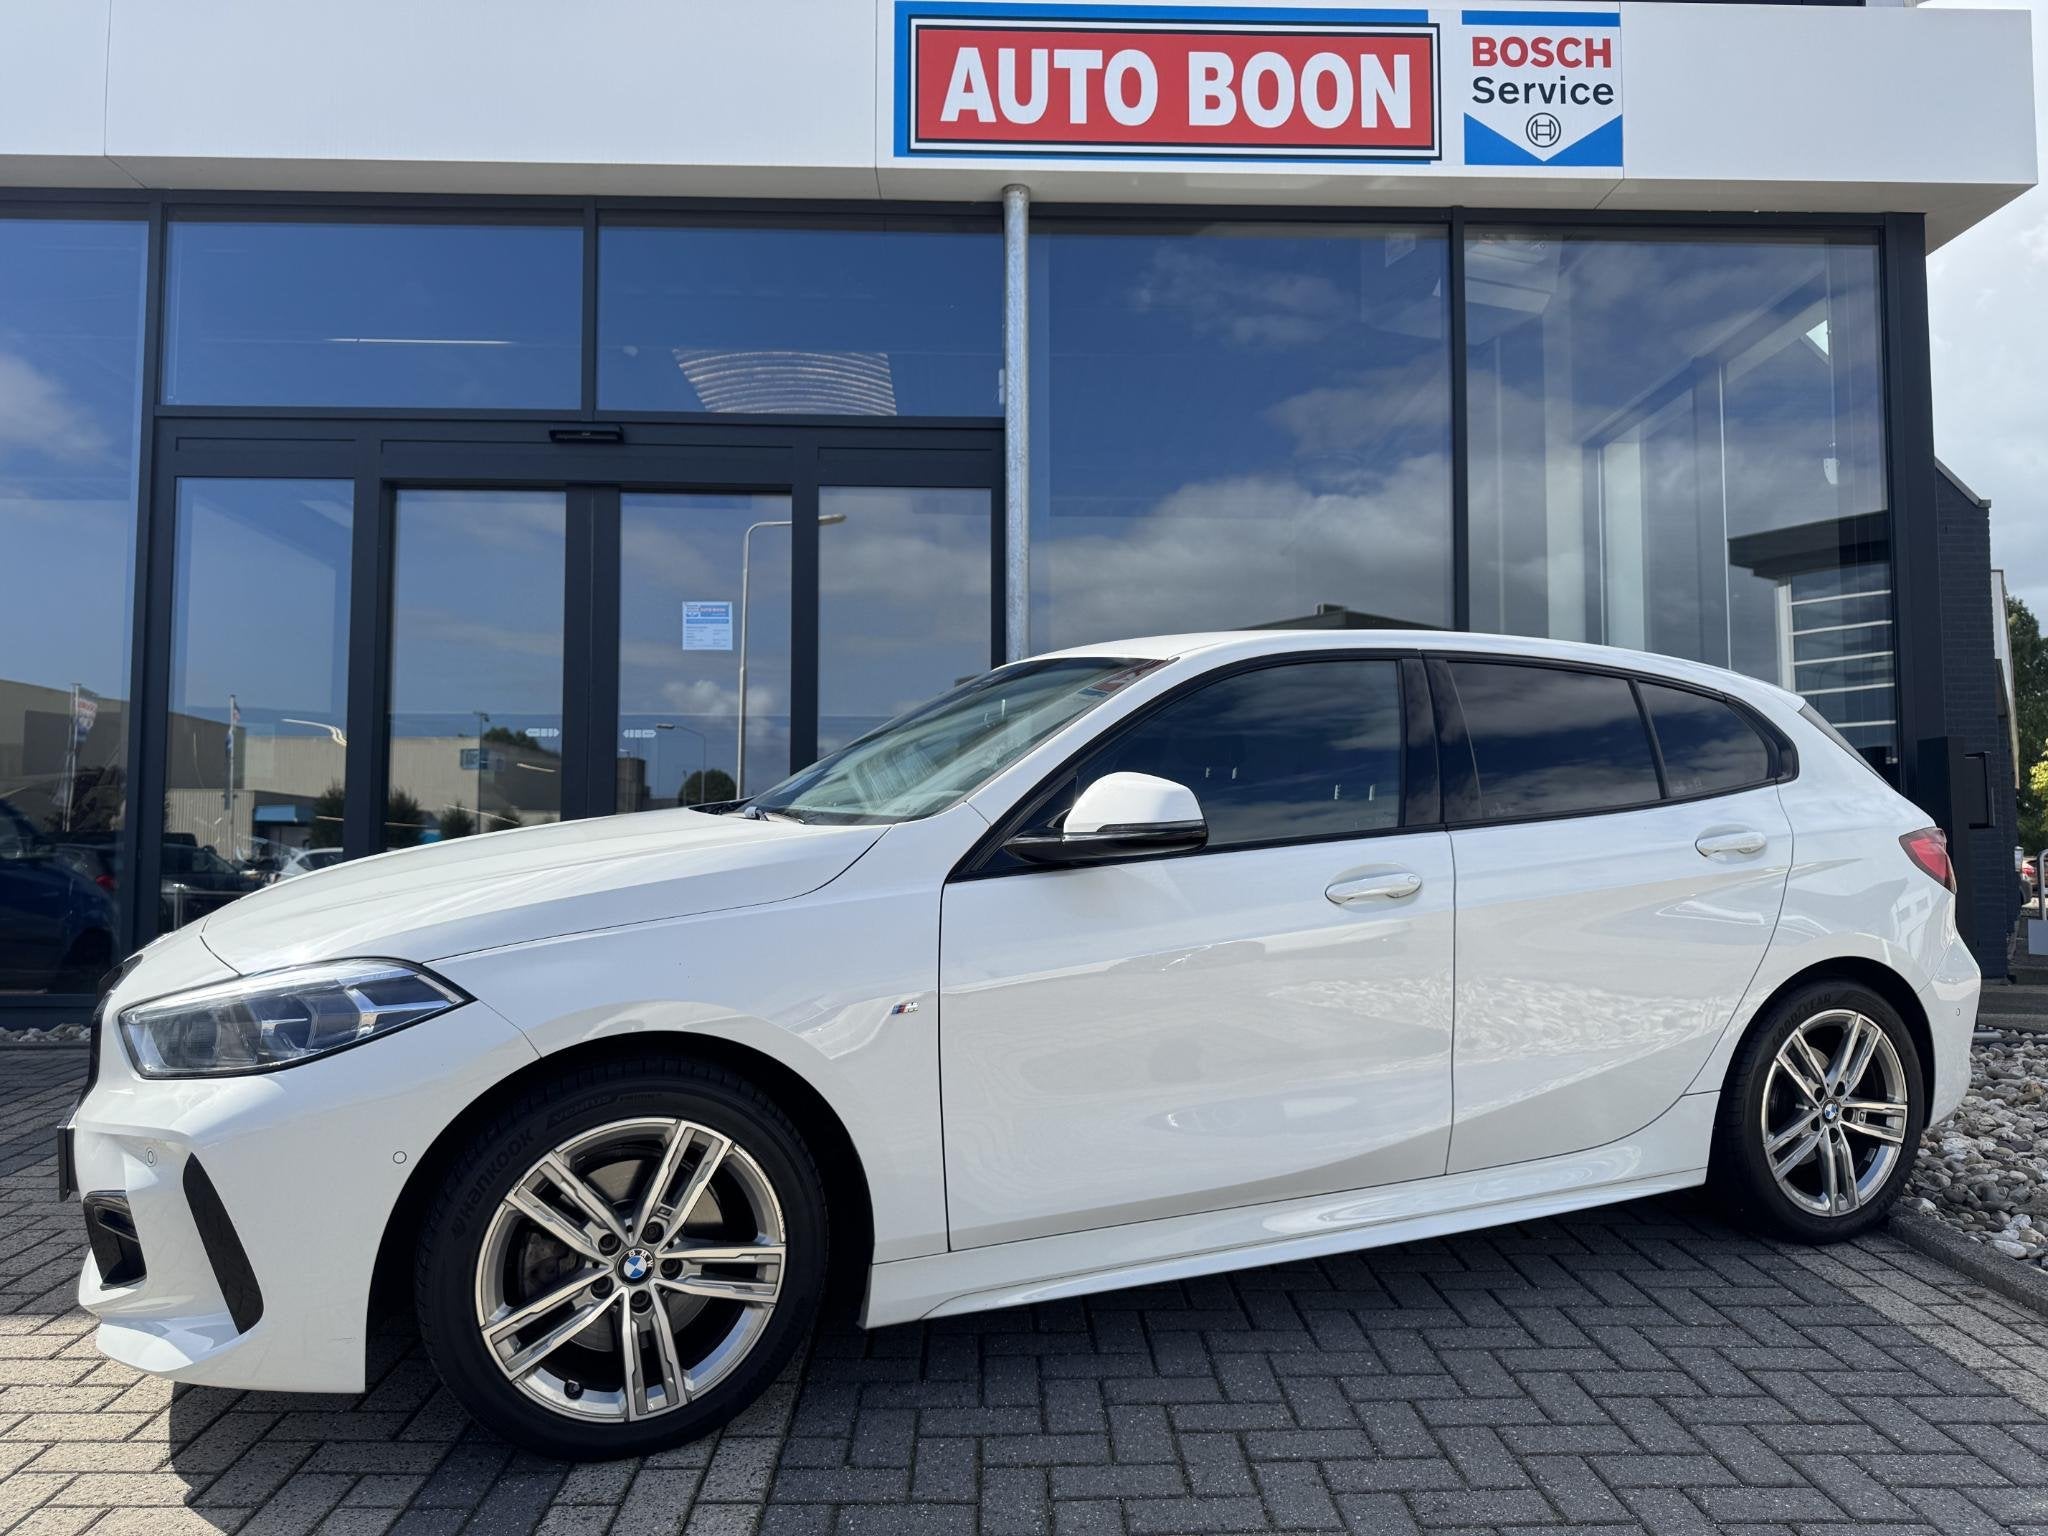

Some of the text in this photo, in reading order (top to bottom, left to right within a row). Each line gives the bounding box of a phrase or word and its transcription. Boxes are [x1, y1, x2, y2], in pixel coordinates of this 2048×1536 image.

[1472, 36, 1612, 69] BOSCH
[940, 47, 1412, 129] AUTO BOON
[1472, 75, 1615, 105] Service
[628, 1249, 654, 1268] BMW
